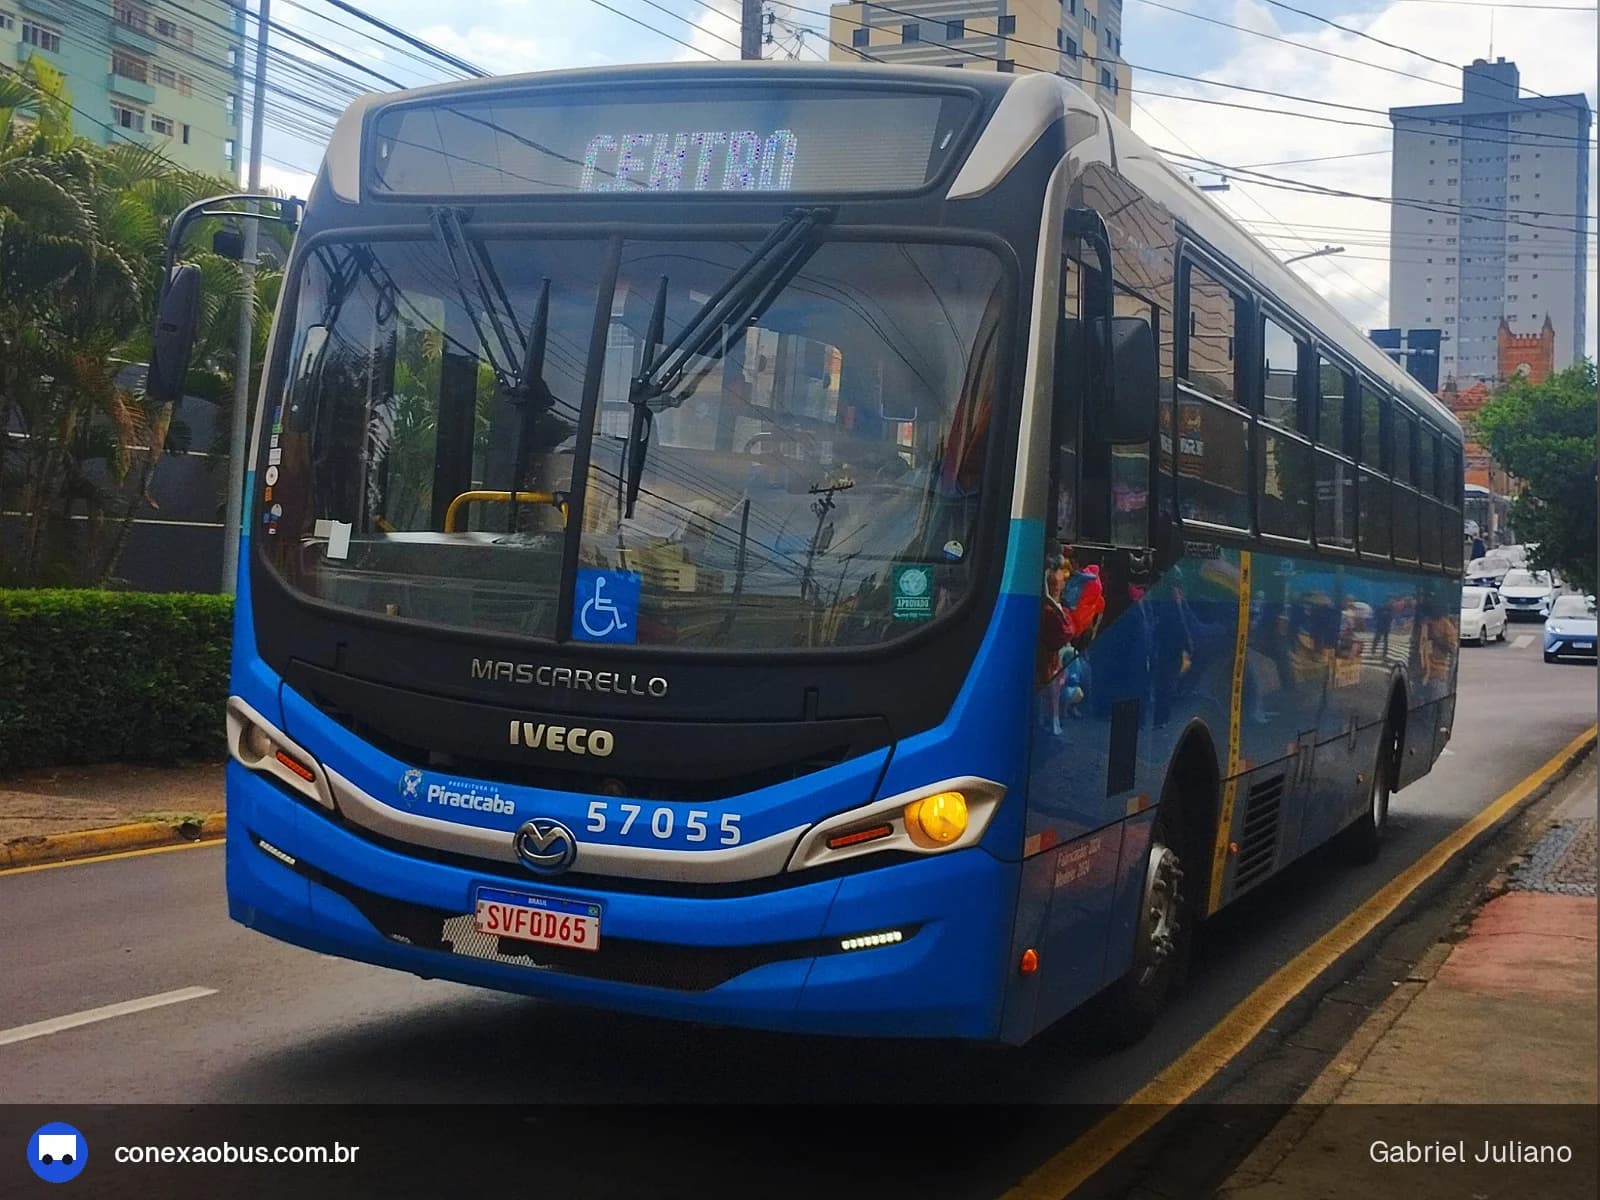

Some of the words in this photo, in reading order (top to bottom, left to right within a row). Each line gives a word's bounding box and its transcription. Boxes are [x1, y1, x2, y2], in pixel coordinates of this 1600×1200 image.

[578, 129, 798, 192] CENTRO
[897, 599, 929, 608] APROVADO
[471, 658, 668, 697] MASCARELLO
[510, 720, 614, 757] IVECO
[427, 784, 515, 815] Piracicaba
[586, 801, 741, 845] 57055
